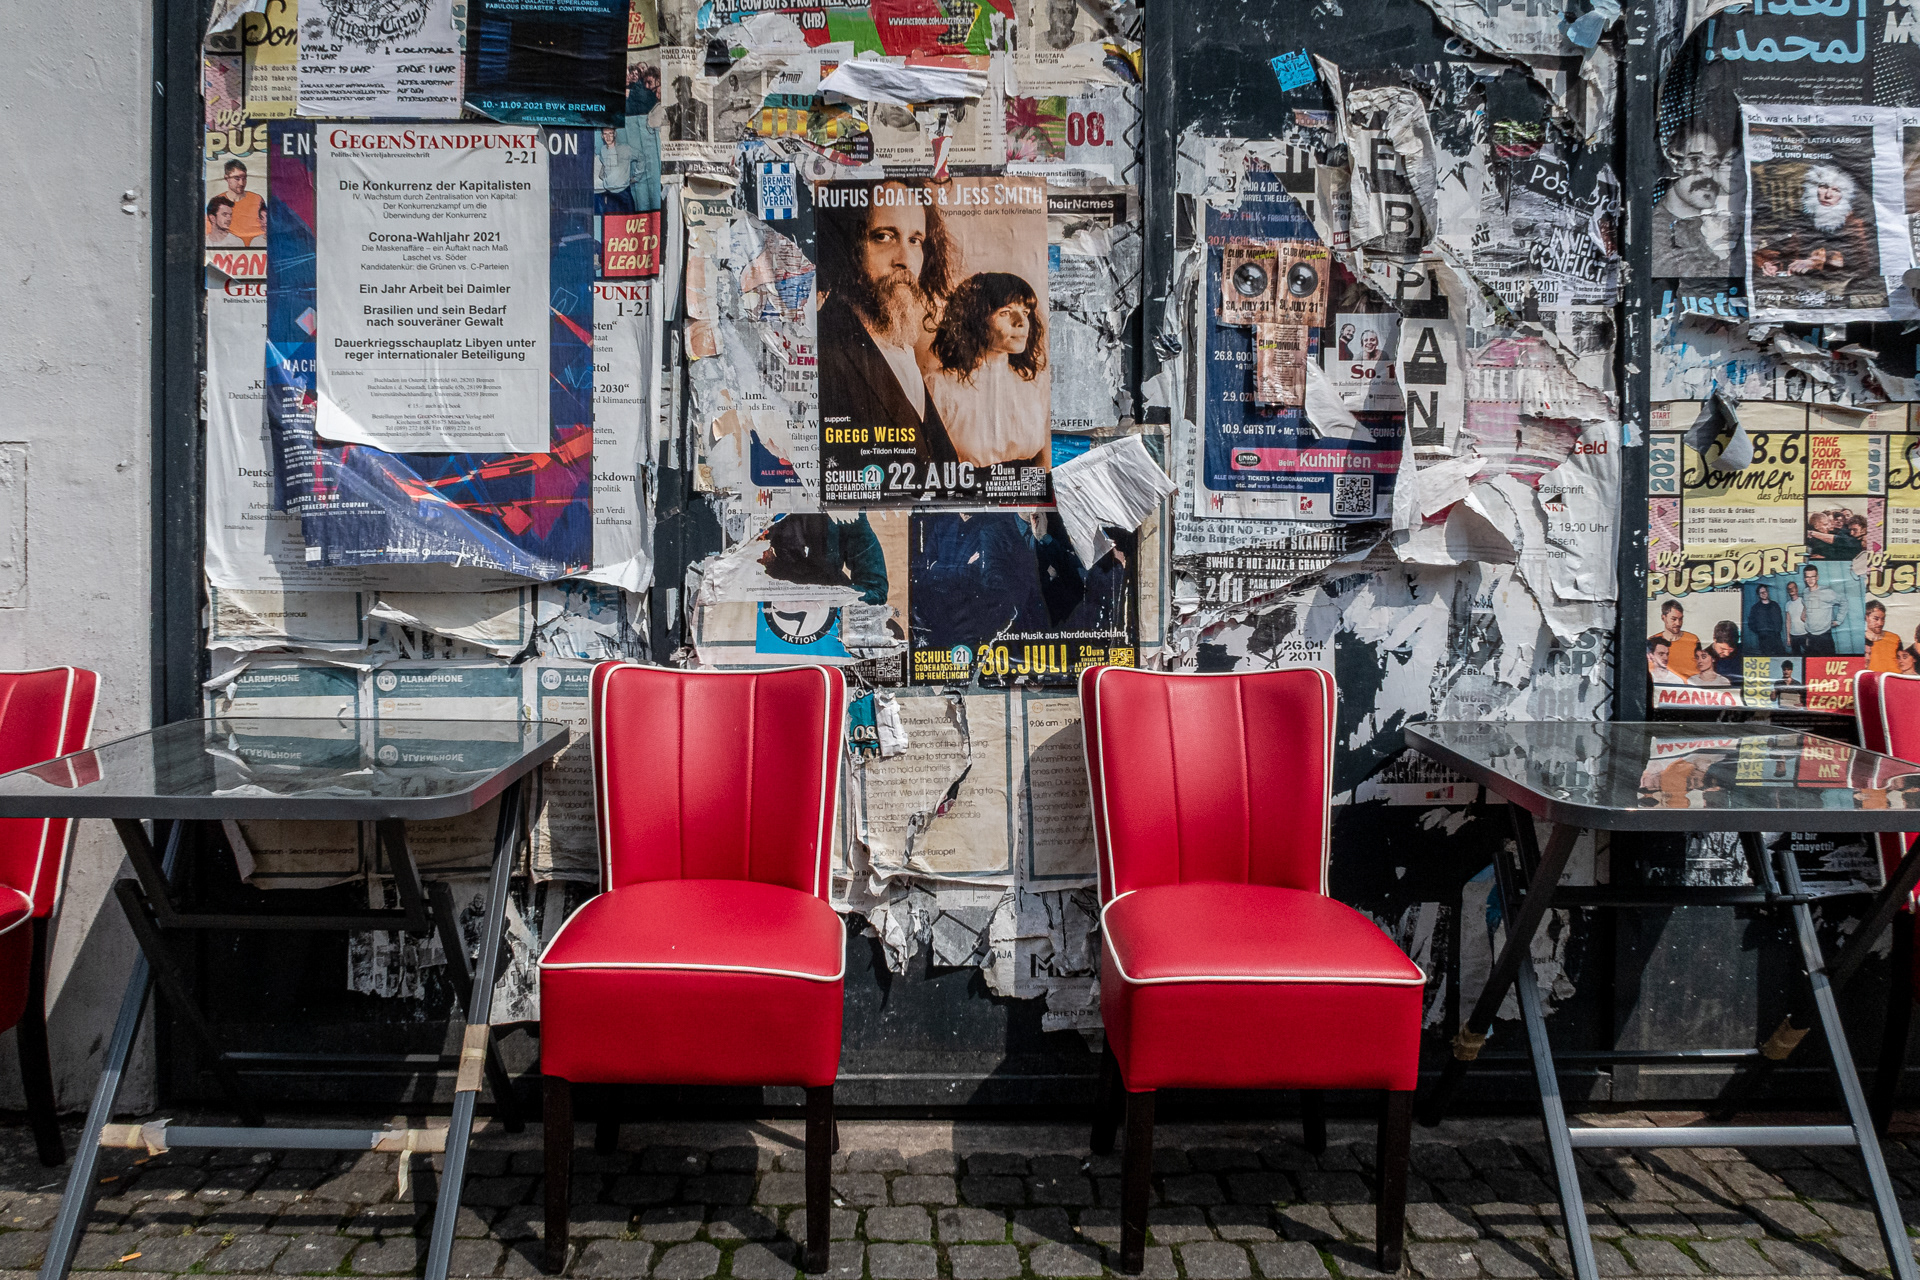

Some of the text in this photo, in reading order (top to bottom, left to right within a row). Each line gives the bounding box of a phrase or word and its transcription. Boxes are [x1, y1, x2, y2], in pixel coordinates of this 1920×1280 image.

[485, 3, 519, 11] FABULOUS
[802, 12, 826, 29] (HB)
[1705, 19, 1866, 64] لمحمد!
[500, 102, 543, 110] 11.09.2021
[545, 103, 566, 111] BWK
[568, 104, 606, 113] BREMEN
[1067, 111, 1114, 148] 08.
[329, 129, 538, 151] GEGENSTANDPUNKT
[505, 151, 538, 164] 2-21
[339, 180, 532, 193] Die Konkurrenz der Kapitalisten
[762, 175, 792, 186] BREMER
[762, 185, 792, 196] SPORT
[817, 184, 1043, 209] RUFUS COATES & JESS SMITH
[364, 192, 402, 200] Wachstum
[403, 192, 424, 200] durch
[425, 192, 473, 200] Zentralisation
[490, 192, 519, 202] Kapital:
[762, 195, 793, 207] VEREIN
[383, 202, 397, 210] Der
[398, 202, 461, 211] Konkurrenzkampf
[475, 202, 488, 210] die
[939, 206, 1042, 218] hypnagogic dark folk/ireland
[383, 211, 488, 221] Überwindung der Konkurrenz
[625, 217, 648, 234] WE
[368, 231, 503, 244] Corona-Wahljahr 2021
[607, 233, 659, 253] HAD TO
[362, 244, 374, 252] Die
[375, 244, 425, 252] Maskenaffäre
[432, 244, 444, 252] ein
[445, 244, 471, 252] Auftakt
[472, 244, 491, 252] nach
[402, 253, 432, 261] Laschet
[445, 253, 468, 261] Söder
[607, 253, 654, 270] LEAVE
[360, 262, 416, 271] Kandidatenkür:
[416, 262, 428, 271] die
[429, 262, 457, 271] Grünen
[470, 262, 510, 271] C-Parteien
[1529, 243, 1607, 286] CONFLICT
[359, 283, 511, 294] Ein Jahr Arbeit bei Daimler
[363, 304, 508, 315] Brasilien und sein Bedarf
[1239, 302, 1258, 312] JULY
[1259, 301, 1270, 312] 31
[1288, 301, 1319, 313] JULY 31
[366, 316, 505, 327] nach souveräner Gewalt
[334, 337, 537, 350] Dauerkriegsschauplatz Libyen unter
[344, 350, 526, 363] reger internationaler Beteiligung
[1350, 364, 1382, 380] So.
[823, 415, 852, 424] support:
[1651, 411, 1671, 420] START
[824, 425, 916, 443] GREGG WEISS
[1573, 440, 1608, 455] Geld
[1811, 436, 1840, 447] TAKE
[892, 446, 917, 456] Krautz)
[1811, 447, 1841, 459] YOUR
[1238, 455, 1258, 463] UNION
[1278, 452, 1372, 470] Beim Kuhhirten
[1649, 436, 1675, 492] 2021
[1810, 458, 1847, 470] PANTS
[824, 469, 878, 484] SCHULE 21
[1247, 475, 1271, 483] TICKETS
[1276, 476, 1326, 484] CORONAKONZEPT
[1538, 484, 1585, 495] Zeitschrift
[1809, 480, 1853, 492] LONELY
[824, 491, 881, 501] HB-HEMELINGEN
[1756, 486, 1806, 503] des Jahres
[340, 501, 370, 510] COMPANY
[606, 506, 626, 515] Verdi
[595, 516, 633, 526] Lufthansa
[1588, 523, 1610, 534] Uhr
[1175, 532, 1248, 546] Paleo Burger
[1290, 536, 1347, 552] SKANDALE
[1206, 556, 1235, 569] SWING
[1246, 557, 1263, 570] HOT
[1265, 557, 1288, 571] JAZZ
[1657, 551, 1690, 567] Wo?
[1646, 544, 1810, 601] PUSDØRF
[1205, 575, 1244, 603] 20H
[781, 634, 818, 645] AKTION
[997, 629, 1128, 640] Echte Musik aus Norddeutschland
[1283, 640, 1327, 652] 26.04.
[914, 650, 967, 664] SCHULE 21
[1824, 660, 1849, 675] WE
[399, 674, 464, 683] ALARMPHONE
[915, 671, 970, 681] HB-HEMELINGEN
[1806, 678, 1839, 692] HAD
[1658, 690, 1736, 707] MANKO
[867, 763, 952, 775] them to hold authorities
[1789, 841, 1835, 854] cinayetti!
